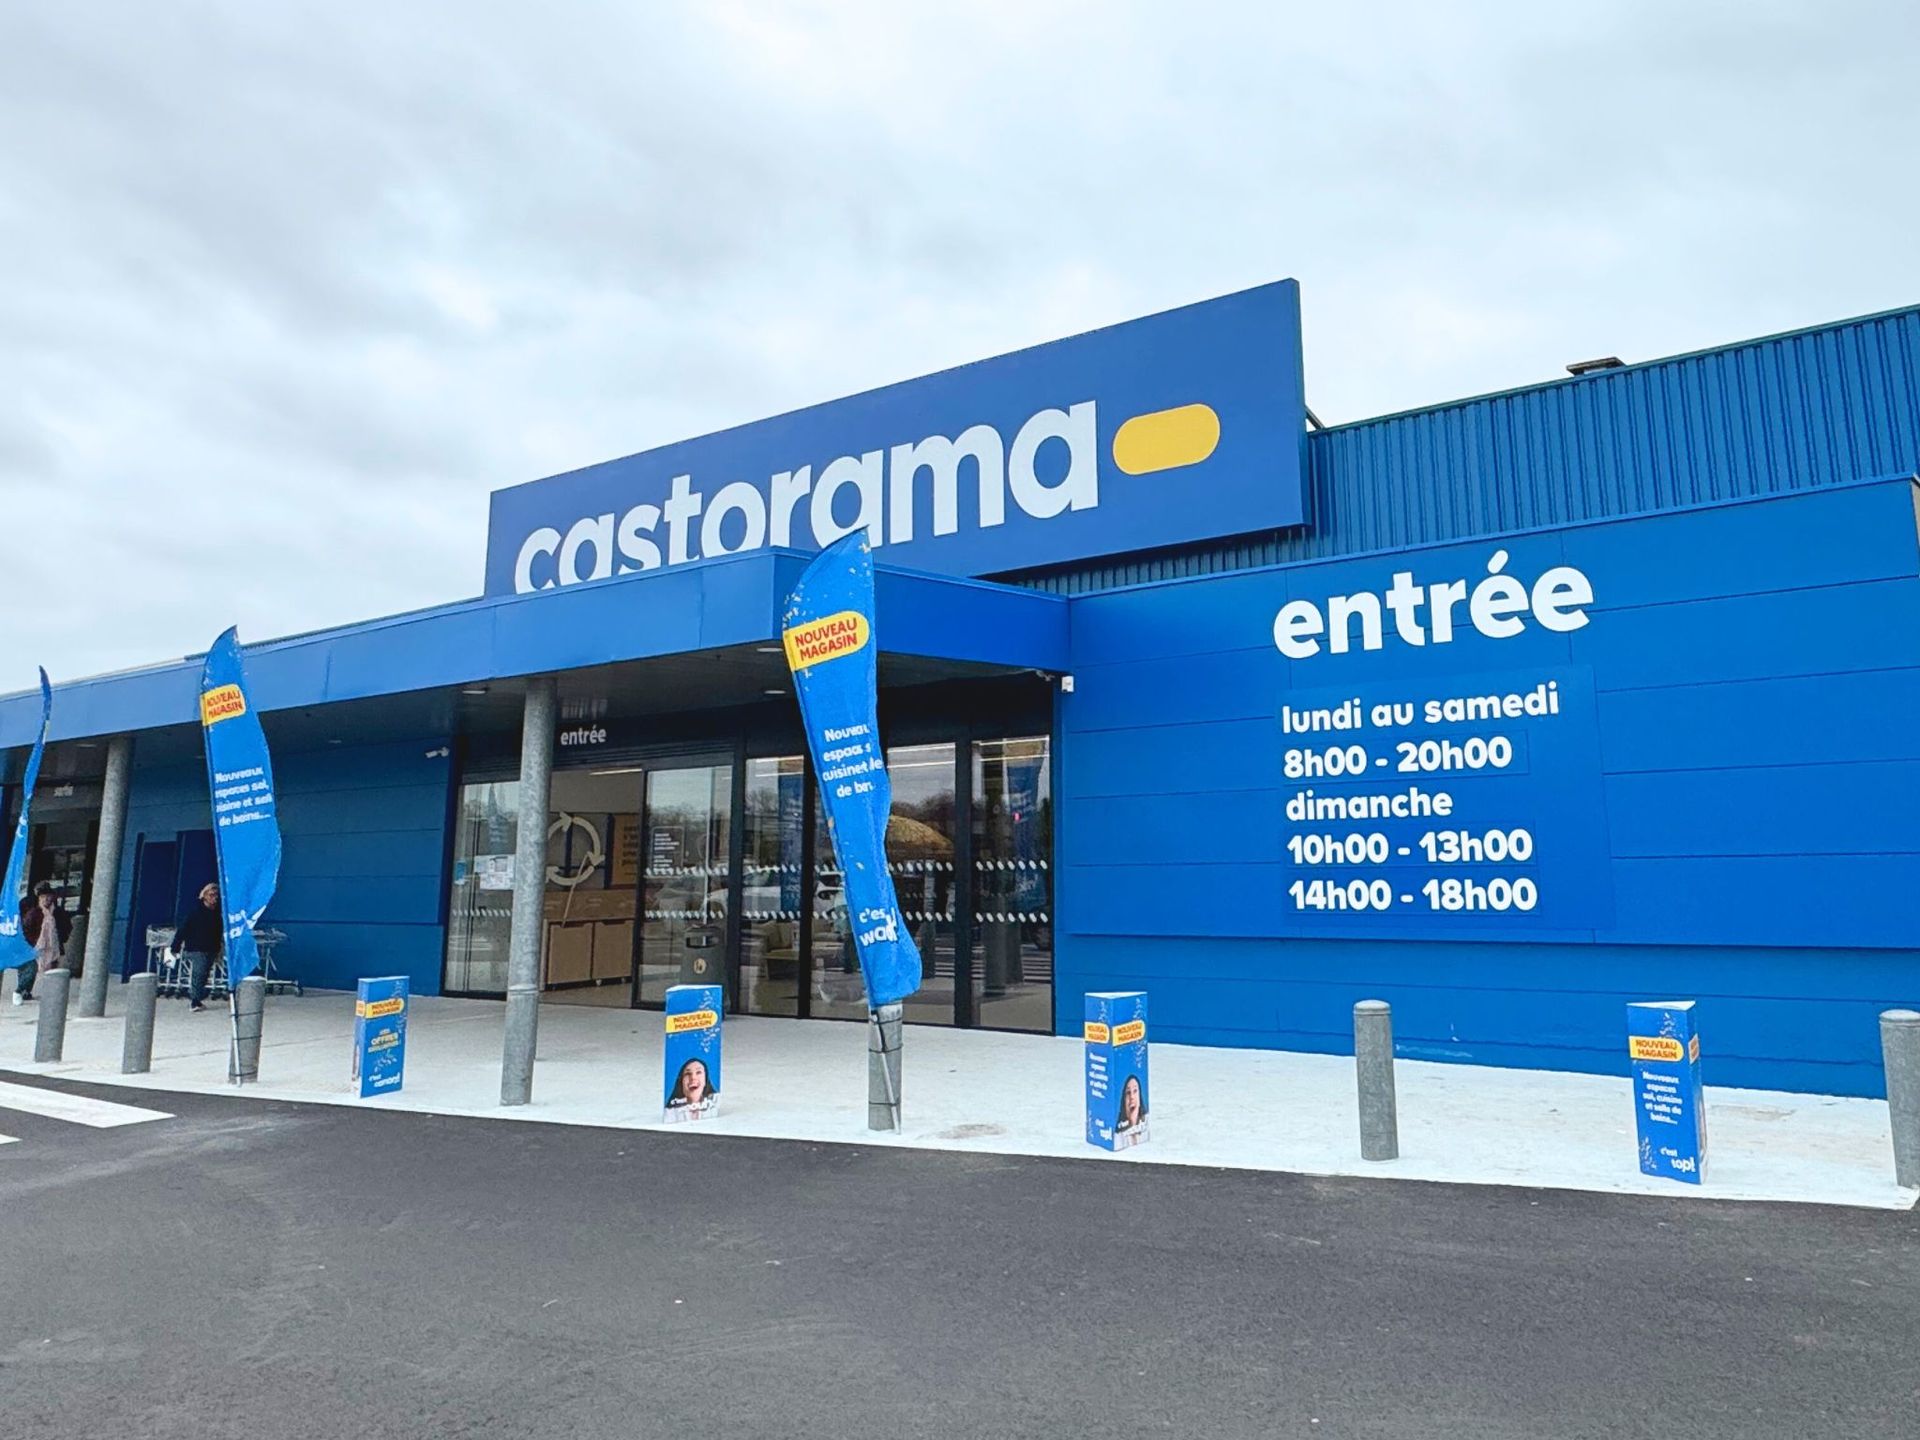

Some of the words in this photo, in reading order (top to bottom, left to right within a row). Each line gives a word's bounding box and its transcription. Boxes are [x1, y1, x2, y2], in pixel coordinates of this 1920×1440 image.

[514, 401, 1099, 594] castorama
[1273, 550, 1594, 659] entrée
[795, 617, 857, 648] NOUVEAU
[800, 632, 858, 662] MAGASIN
[1282, 697, 1362, 734] lundi
[1371, 702, 1414, 728] au
[1424, 681, 1560, 724] samedi
[560, 724, 607, 746] entrée
[1283, 745, 1367, 779] 8h00
[1396, 736, 1512, 773] 20h00
[836, 784, 852, 798] de
[1286, 787, 1454, 822] dimanche
[1287, 832, 1389, 865] 10h00
[1419, 829, 1533, 863] 13h00
[1288, 879, 1392, 911] 14h00
[1422, 877, 1538, 911] 18h00
[859, 907, 886, 923] c'es
[673, 1012, 713, 1023] NOUVEAU
[675, 1020, 712, 1031] MAGASIN
[1635, 1039, 1678, 1051] NOUVEAU
[1637, 1048, 1678, 1060] MAGASIN
